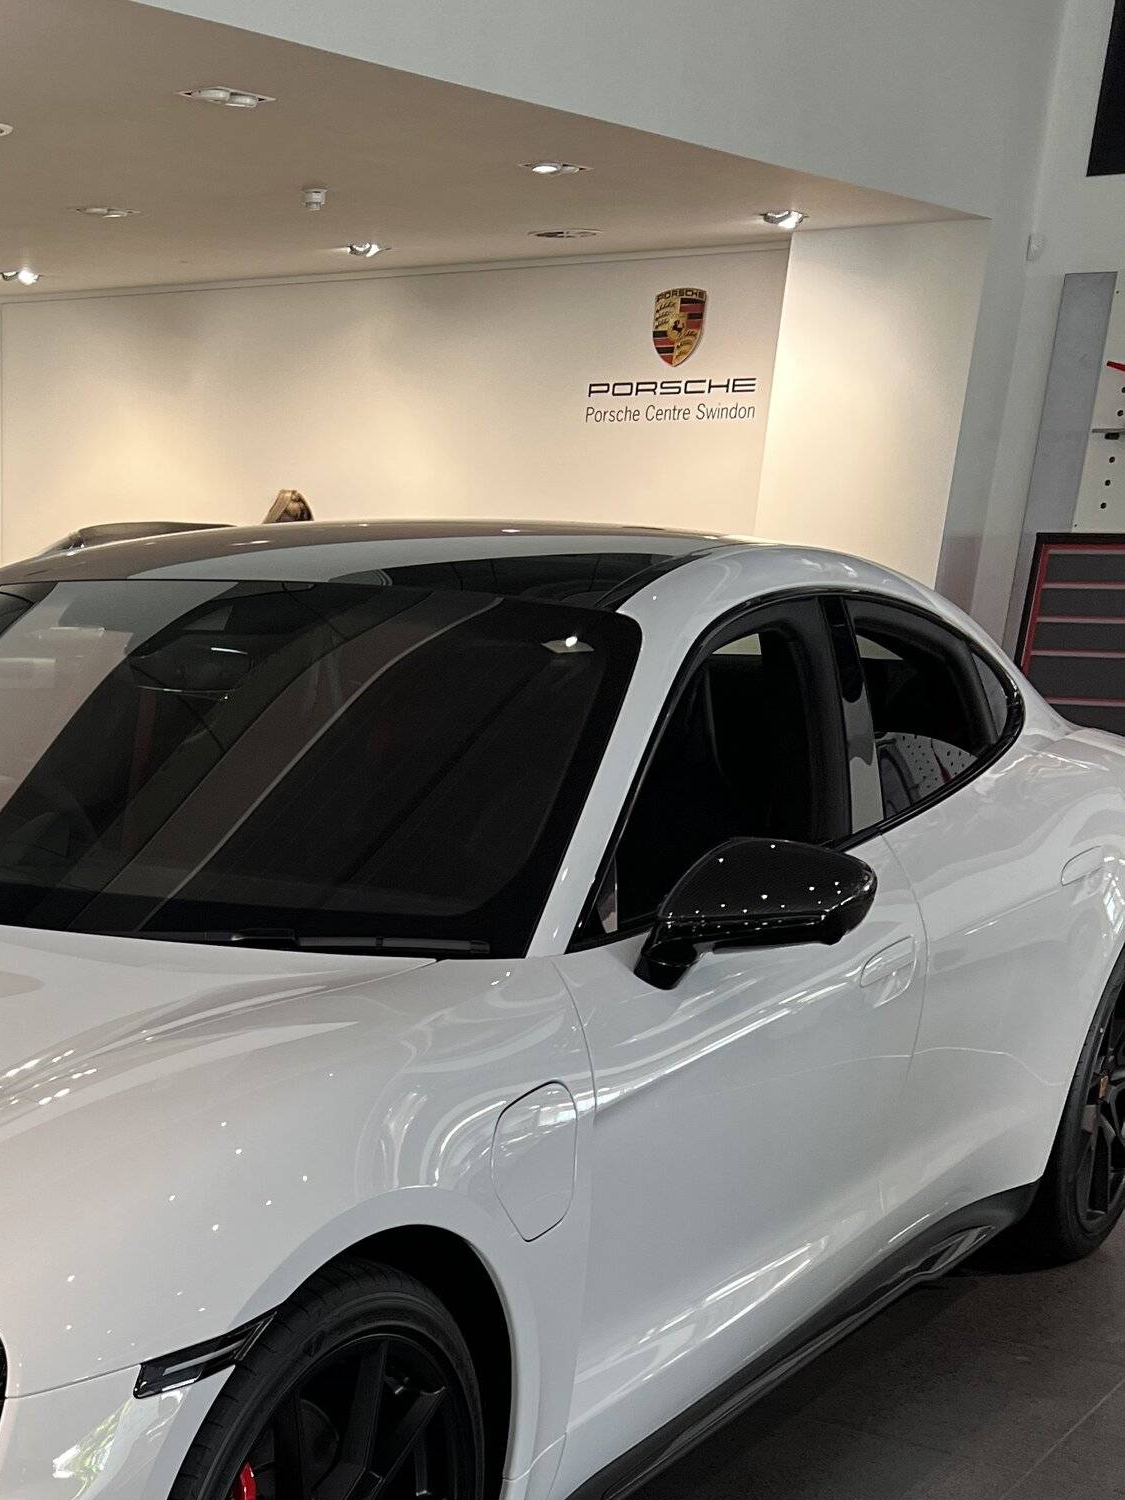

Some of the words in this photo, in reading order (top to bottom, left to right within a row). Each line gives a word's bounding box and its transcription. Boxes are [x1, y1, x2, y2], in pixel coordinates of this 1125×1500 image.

[587, 377, 757, 398] PORSCHE
[585, 406, 640, 423] Porsche
[645, 404, 691, 421] Centre
[695, 402, 756, 420] Swindon
